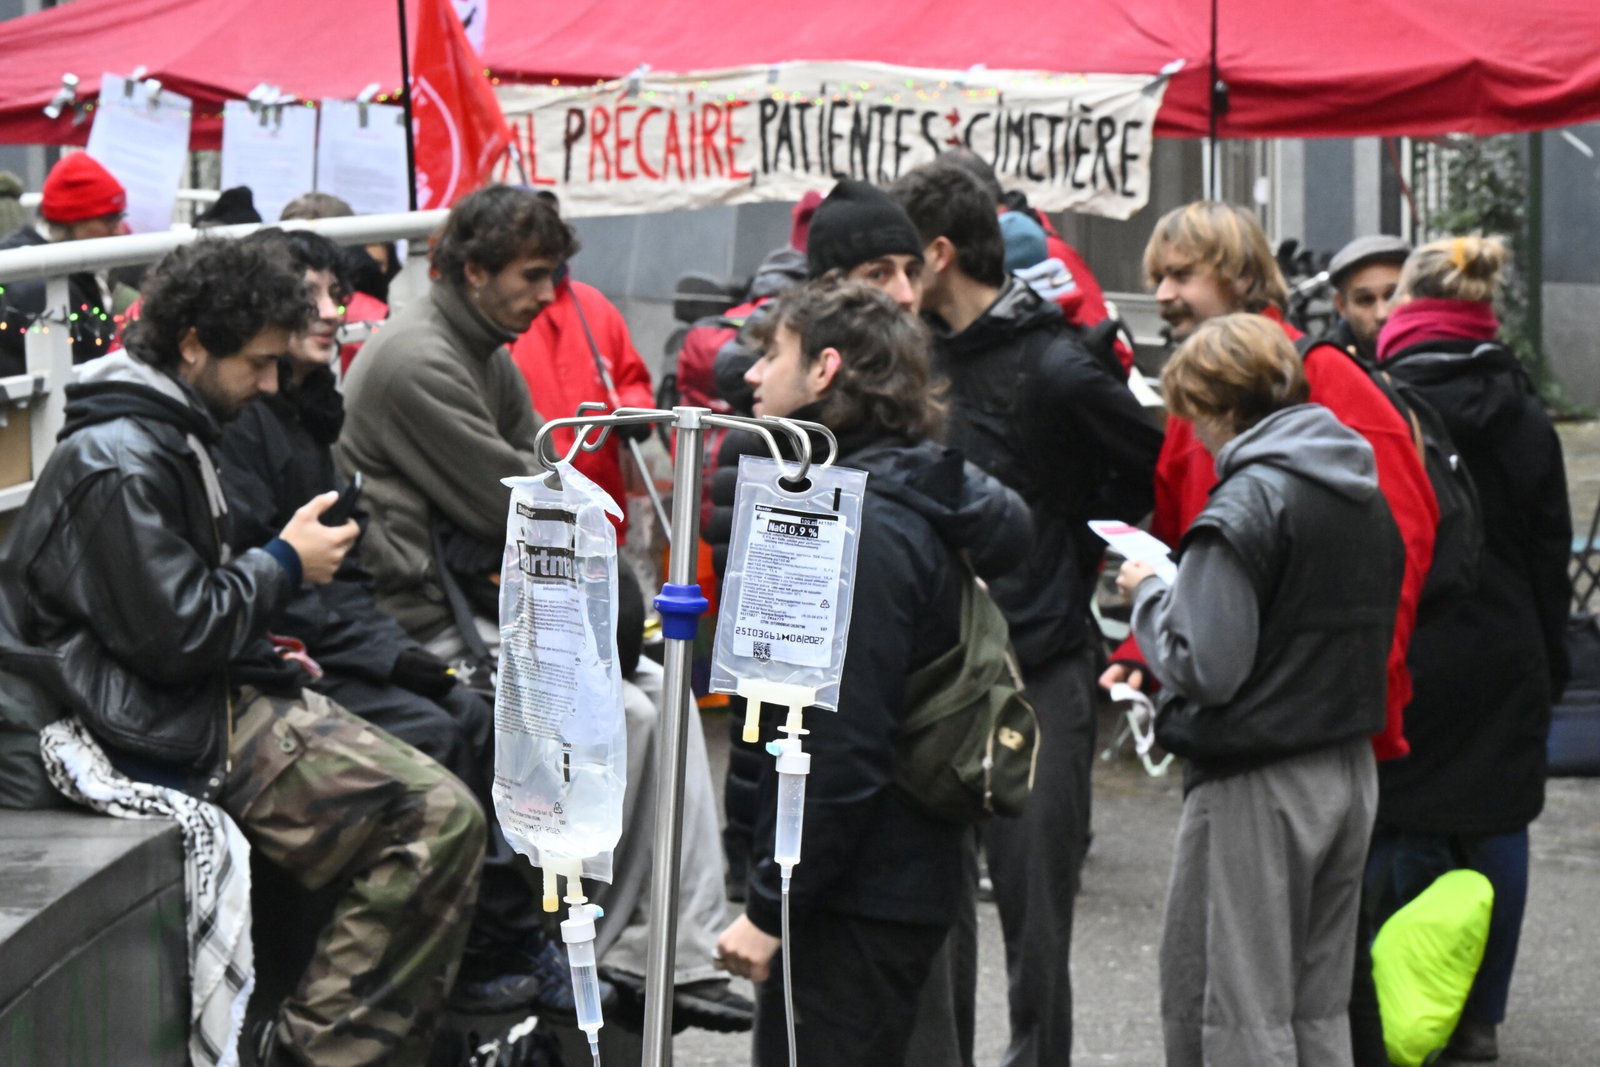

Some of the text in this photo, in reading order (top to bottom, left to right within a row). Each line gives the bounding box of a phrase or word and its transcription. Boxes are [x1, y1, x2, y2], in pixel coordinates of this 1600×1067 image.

[964, 92, 1143, 198] CIMETIÈRE
[768, 521, 818, 538] NaCl 0,9 %
